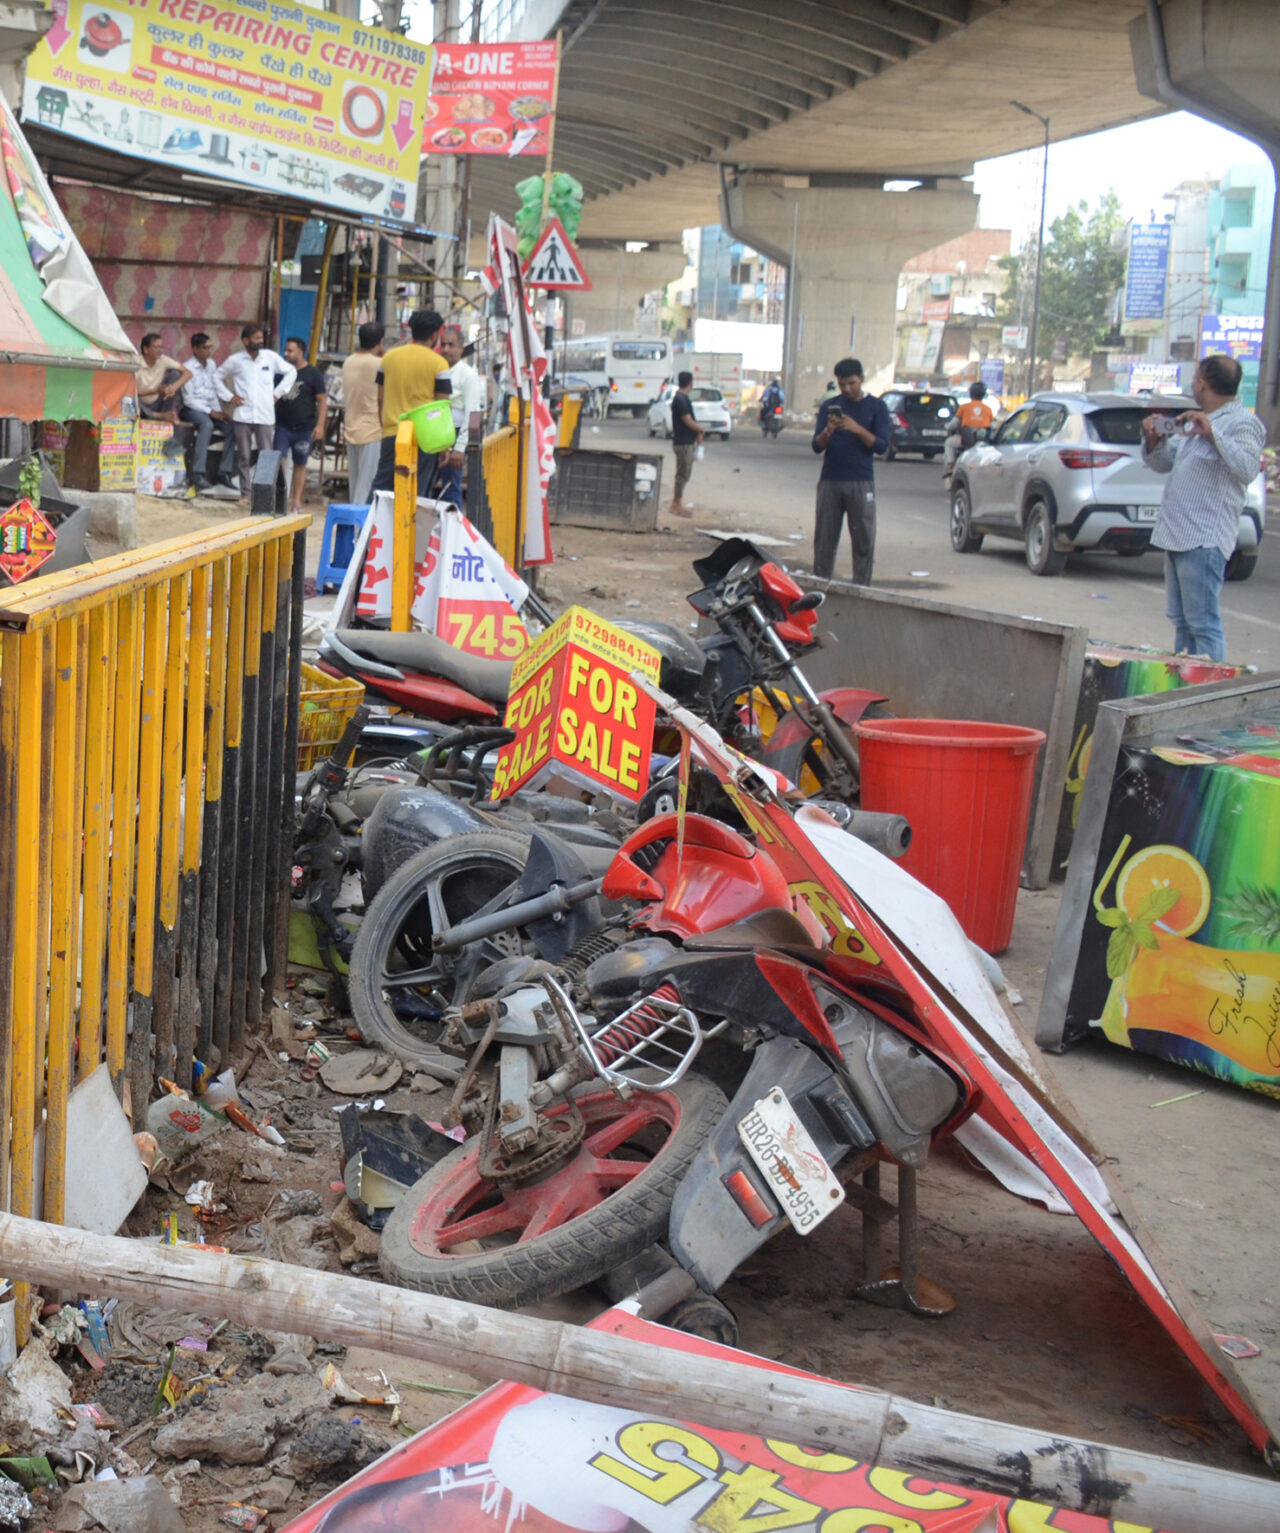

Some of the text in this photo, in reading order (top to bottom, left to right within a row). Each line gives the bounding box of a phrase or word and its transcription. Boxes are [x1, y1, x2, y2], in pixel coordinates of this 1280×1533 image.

[147, 21, 185, 45] कुलर
[188, 31, 204, 50] ही
[207, 40, 245, 62] कुलर
[289, 61, 304, 81] ही
[159, 0, 418, 88] REPAIRING CENTRE
[305, 14, 341, 35] दुकान
[352, 30, 426, 66] 9711978386
[437, 52, 514, 75] A-ONE
[517, 81, 549, 90] CORNER
[52, 64, 73, 81] गैस
[107, 77, 128, 97] गैस
[228, 111, 247, 129] गैस
[163, 75, 184, 91] सेल
[211, 89, 242, 107] सर्विस
[254, 101, 275, 117] होम
[277, 107, 308, 124] सर्विस
[505, 666, 555, 729] FOR
[569, 652, 638, 730] FOR
[491, 714, 553, 801] SALE
[557, 707, 642, 792] SALE
[740, 1111, 781, 1162] HR26
[784, 1184, 821, 1228] 4955
